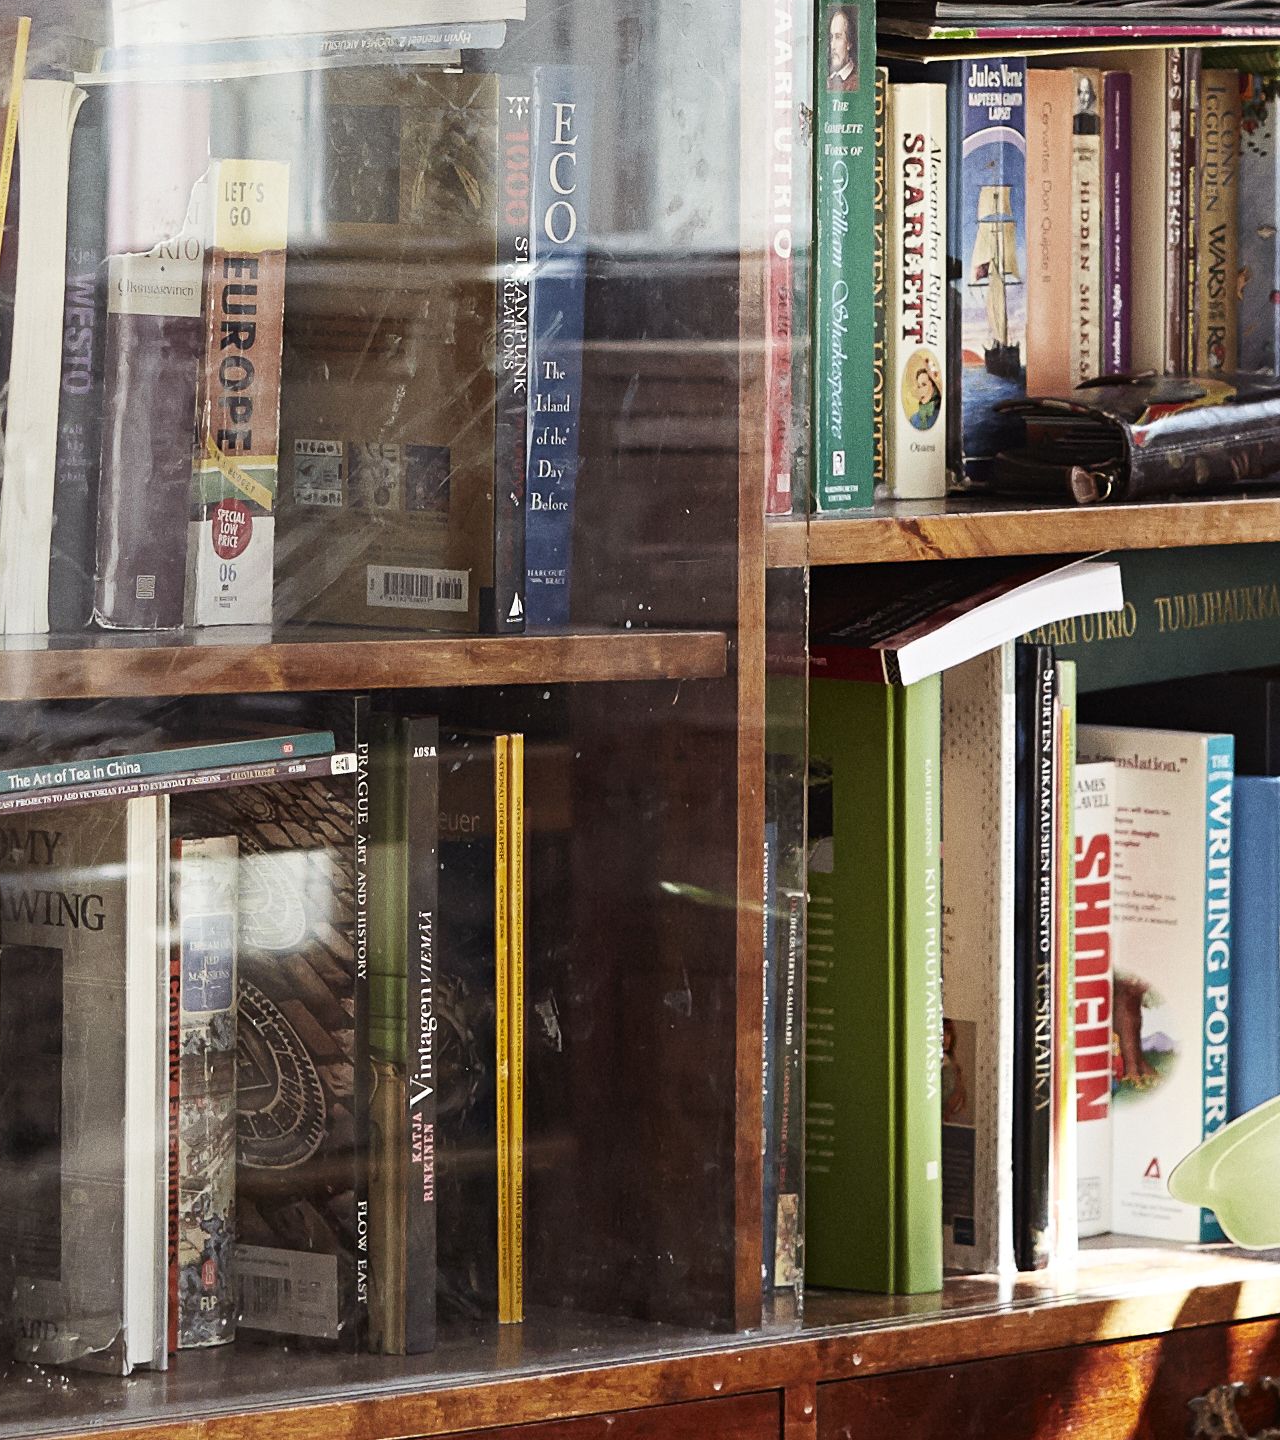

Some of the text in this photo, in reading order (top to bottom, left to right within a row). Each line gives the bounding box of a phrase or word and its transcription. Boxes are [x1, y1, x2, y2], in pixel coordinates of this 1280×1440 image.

[399, 35, 407, 46] 2
[444, 29, 471, 45] Hyvin
[969, 64, 1000, 87] Jules
[1041, 102, 1053, 173] Cervantes
[1206, 86, 1228, 212] IGGULDEN
[1221, 111, 1235, 188] CONN
[224, 181, 265, 203] LET'S
[503, 127, 529, 226] 1000
[544, 102, 578, 244] ECO
[773, 128, 793, 259] UTRIO
[1041, 181, 1053, 214] Don
[229, 206, 251, 227] GO
[828, 160, 850, 268] William
[901, 132, 925, 345] SCARLETT
[925, 137, 942, 347] Alexandra Ripley
[1038, 217, 1053, 273] Quijote
[1079, 181, 1091, 272] HIDDEN
[1207, 223, 1227, 300] WARS
[216, 257, 260, 451] EUROPE
[543, 360, 565, 381] The
[826, 280, 850, 437] Shakespeare
[535, 393, 570, 413] Island
[536, 426, 567, 446] of the
[530, 490, 569, 511] Before
[538, 460, 565, 482] Day
[217, 508, 245, 525] SPECIAL
[217, 534, 238, 548] PRICE
[220, 522, 238, 536] LOW
[219, 563, 237, 583] 06
[1154, 584, 1280, 633] TUULIHAUKKA
[8, 761, 141, 789] The Art of Tea in China
[15, 794, 51, 808] PROJECTS
[52, 793, 63, 803] TO
[63, 790, 79, 802] ADD
[79, 784, 117, 799] VICTORIAN
[139, 782, 149, 792] TO
[149, 777, 187, 791] EVERYDAY
[187, 774, 222, 787] FASHIONS
[497, 752, 506, 798] NATIONAL
[1039, 669, 1055, 872] SUURTEN AIKAKAUSIEN
[497, 802, 506, 864] GEOGRAPHIC
[924, 758, 933, 858] KARI HEIMONEN
[356, 741, 368, 981] PRAGUE ART AND HISTORY
[1207, 784, 1232, 977] WRITING
[409, 911, 438, 1109] Vintagen VIEMÄÄ
[924, 868, 938, 1100] KIVI PUUTARHASSA
[1073, 832, 1111, 1123] SHOGUN
[785, 987, 795, 1045] GALLIMARD
[1034, 963, 1052, 1112] KESKIAIKA
[412, 1111, 422, 1162] KATJA
[423, 1124, 435, 1202] RINKINEN
[357, 1200, 368, 1304] FLOW EAST
